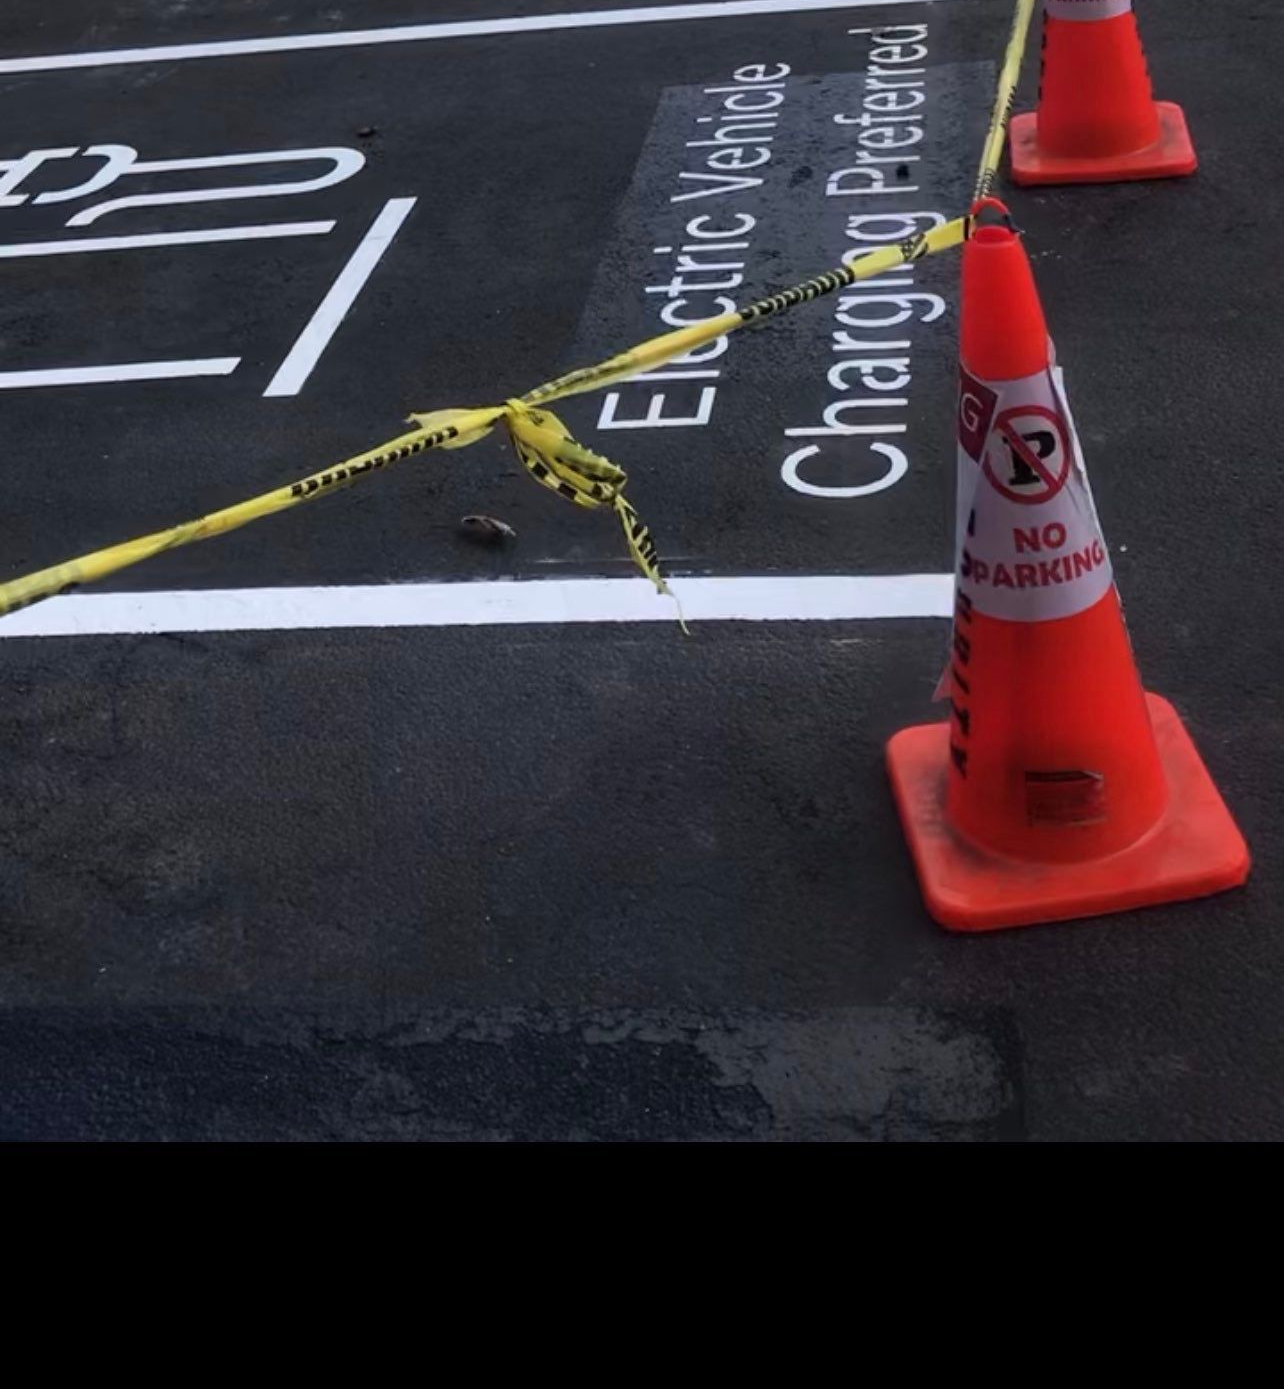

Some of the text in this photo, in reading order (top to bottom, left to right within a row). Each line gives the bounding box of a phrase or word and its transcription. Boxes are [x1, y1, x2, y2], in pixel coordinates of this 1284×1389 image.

[670, 62, 791, 203] Vehicle
[826, 23, 929, 197] Preferred
[968, 539, 1105, 590] PARKING
[1012, 522, 1067, 554] NO
